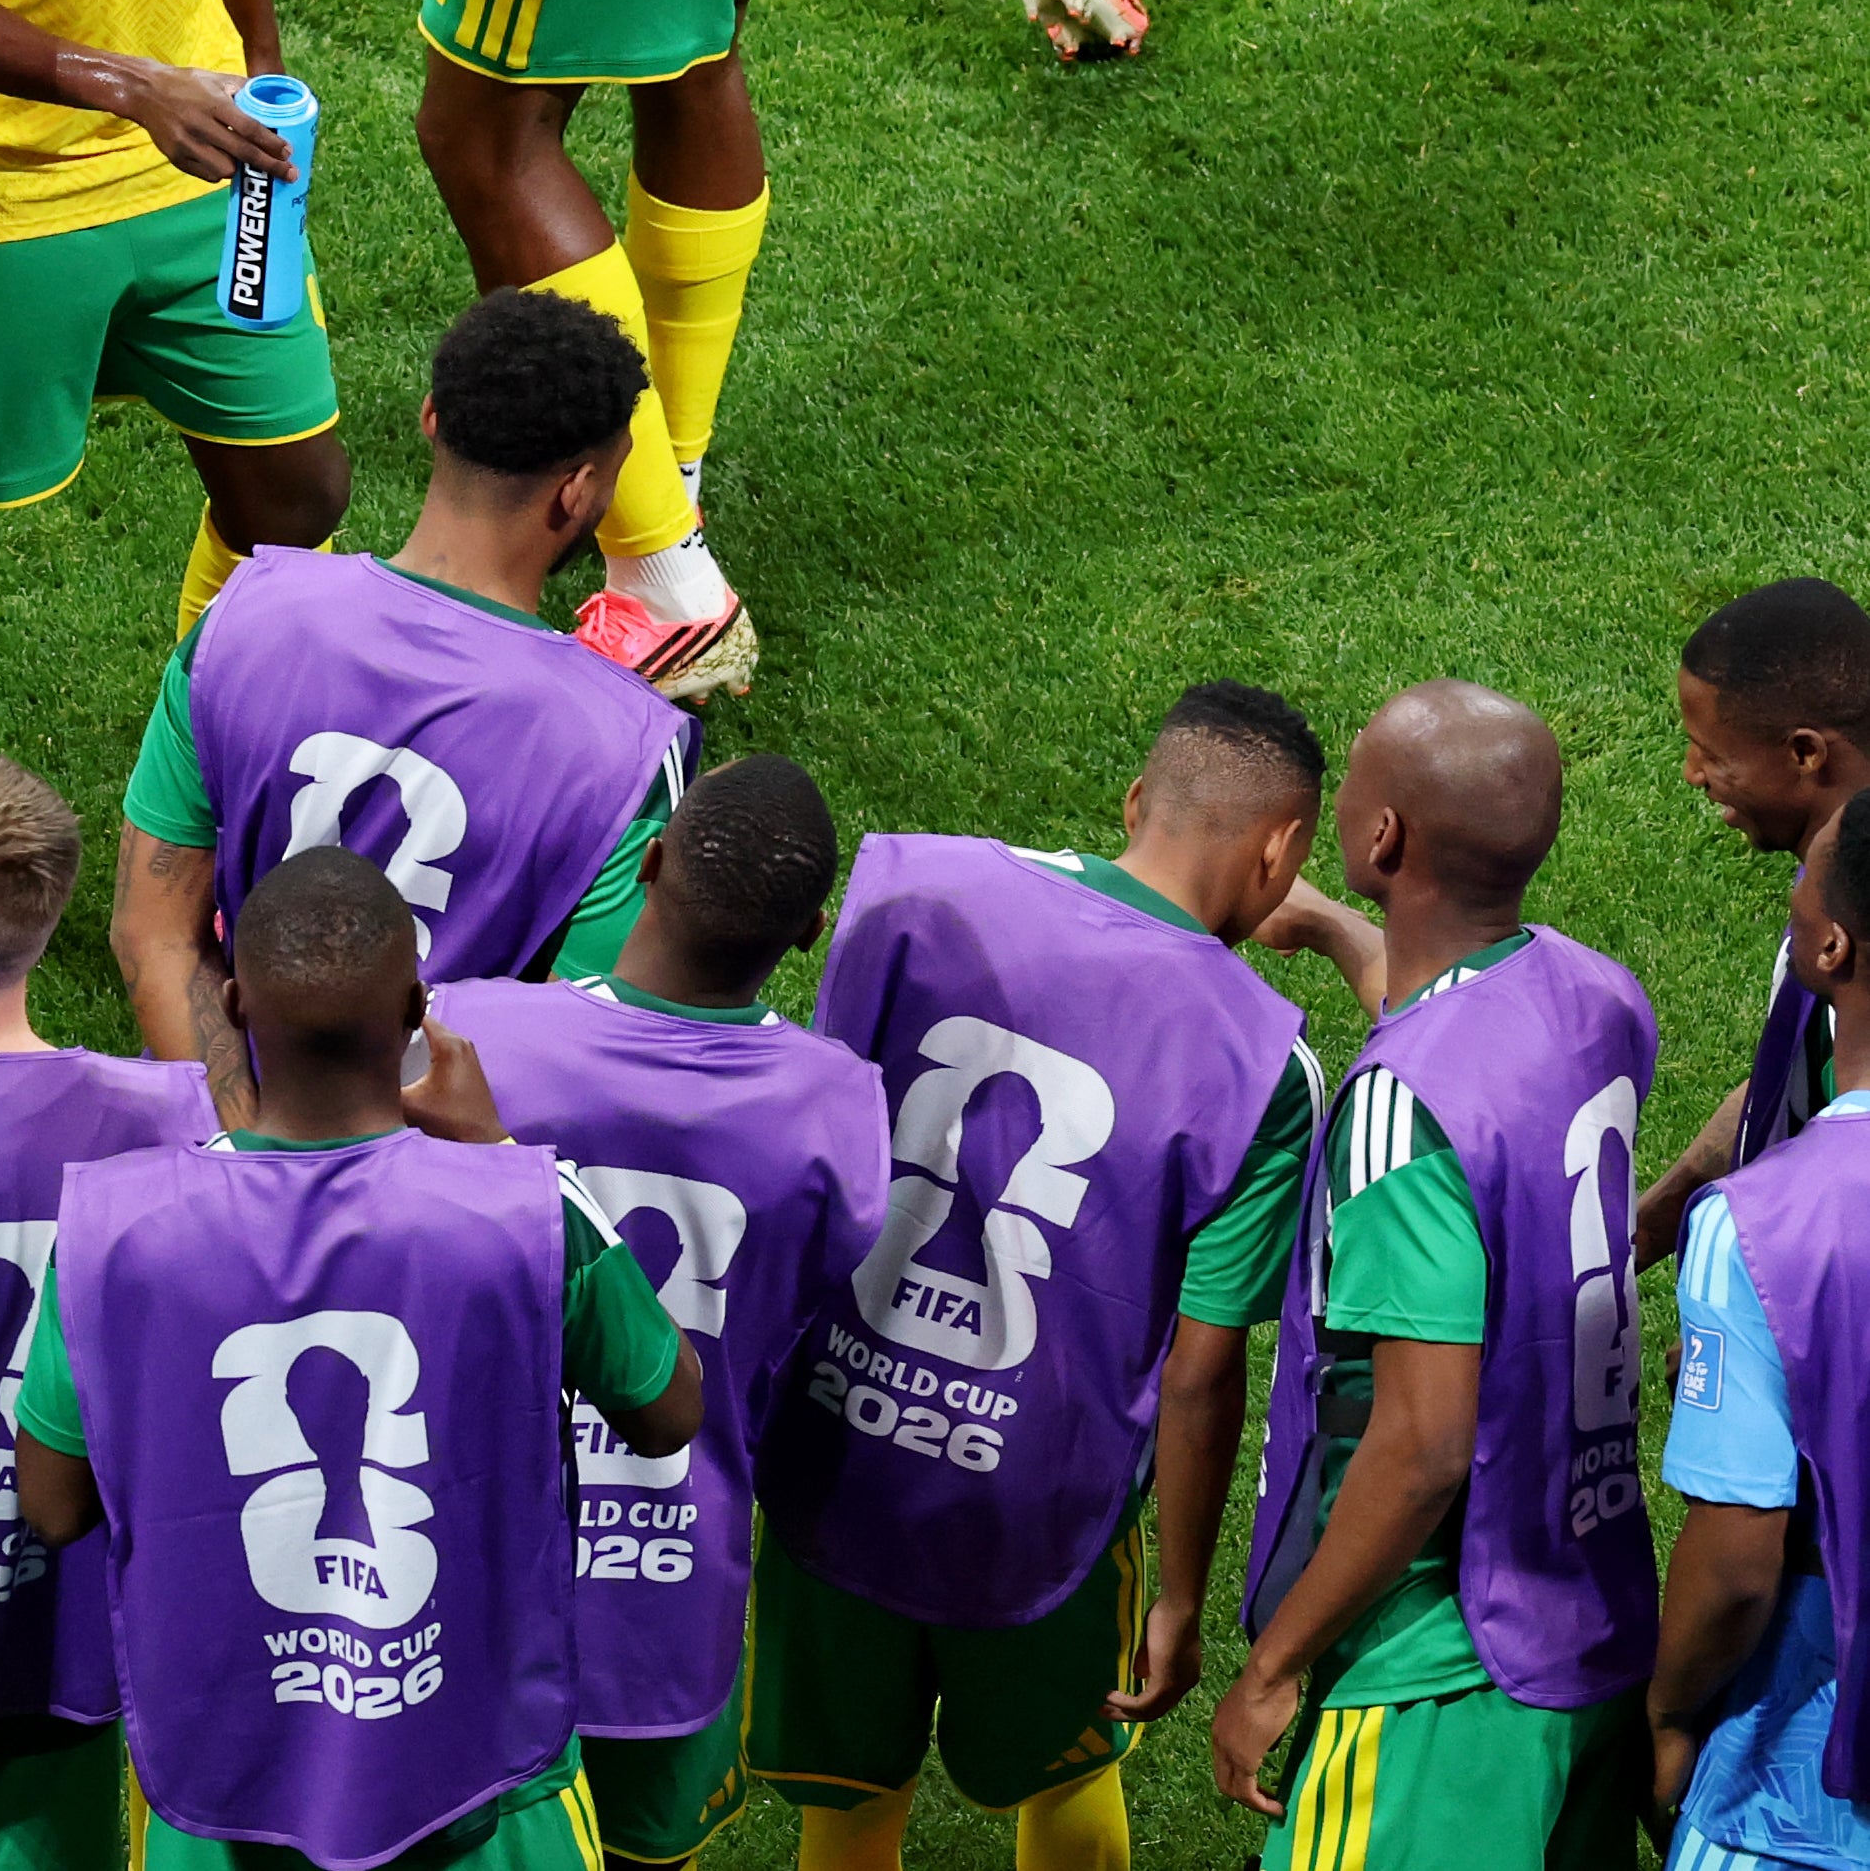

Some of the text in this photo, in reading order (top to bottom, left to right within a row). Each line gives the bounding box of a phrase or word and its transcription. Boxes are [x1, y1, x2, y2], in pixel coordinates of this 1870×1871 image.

[891, 1280, 982, 1337] FIFA
[826, 1323, 1019, 1423] WORLD CUP
[806, 1360, 1005, 1473] 2026
[1571, 1436, 1638, 1486] WORL
[628, 1501, 700, 1532] CUP
[314, 1554, 389, 1600] FIFA
[263, 1622, 443, 1669] WORLD CUP
[270, 1653, 445, 1721] 2026
